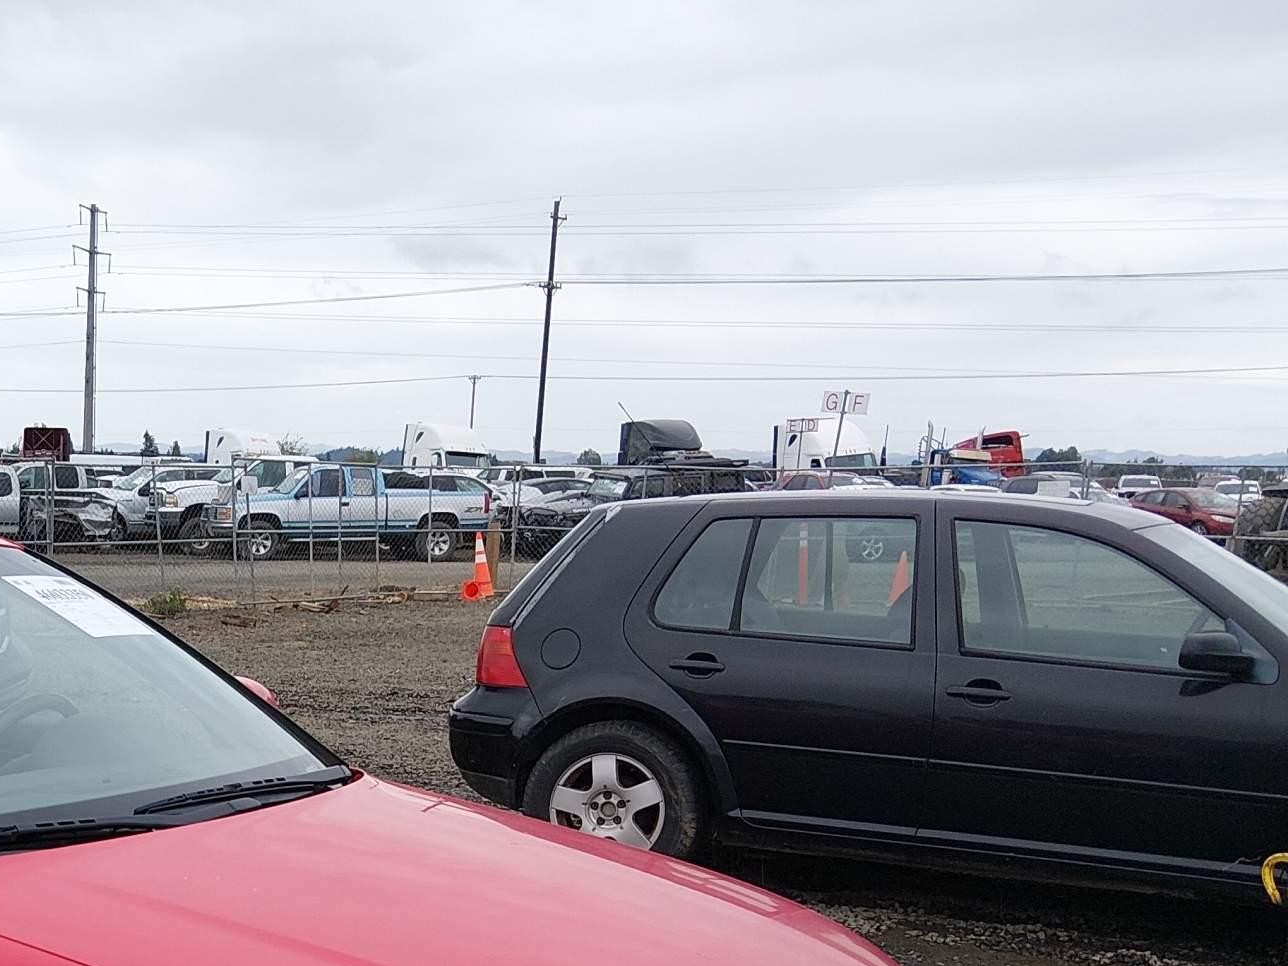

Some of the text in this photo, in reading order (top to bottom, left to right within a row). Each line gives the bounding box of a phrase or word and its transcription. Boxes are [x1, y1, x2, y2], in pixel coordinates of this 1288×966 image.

[825, 393, 865, 412] G F
[807, 419, 816, 432] D
